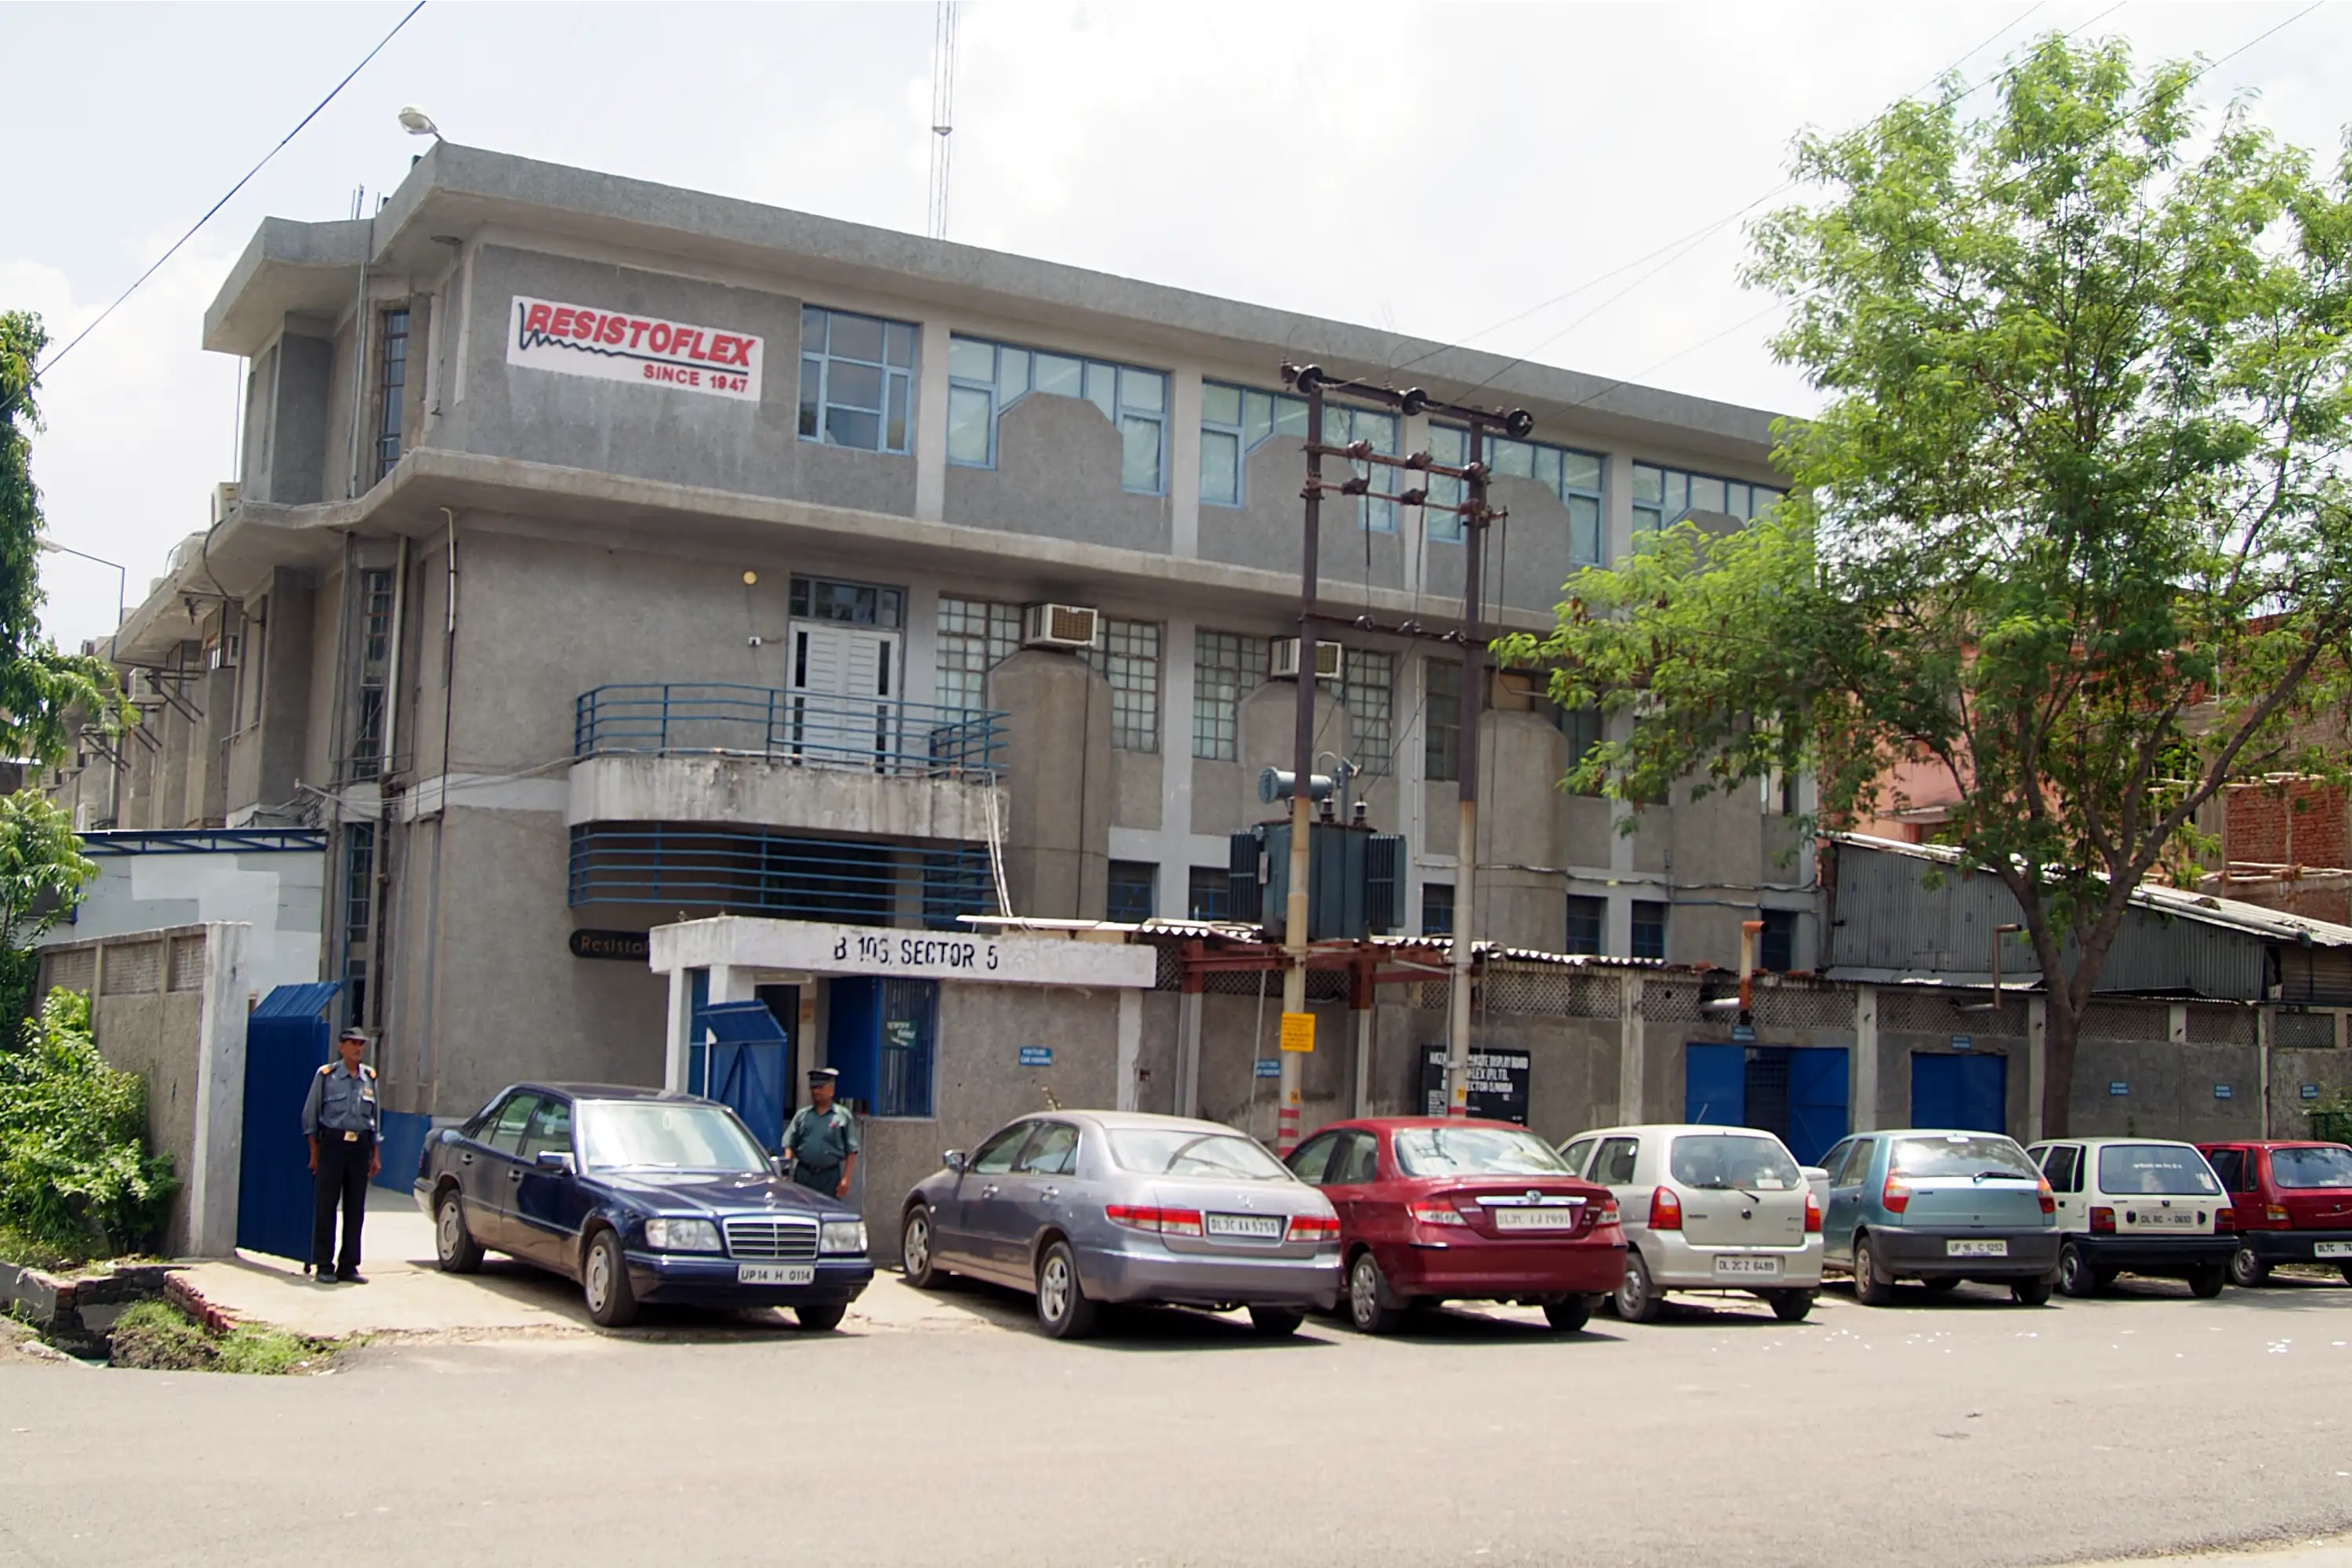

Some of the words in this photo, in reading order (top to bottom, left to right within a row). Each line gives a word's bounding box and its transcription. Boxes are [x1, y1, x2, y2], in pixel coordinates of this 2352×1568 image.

[525, 303, 756, 367] RESISTOFLEX
[643, 364, 700, 386] SINCE
[710, 375, 748, 392] 1947
[834, 937, 847, 960] B
[901, 938, 975, 968] SECTOR
[987, 946, 998, 970] 5
[775, 1271, 782, 1279] H
[789, 1271, 811, 1280] 0114
[1719, 1260, 1730, 1270] DL
